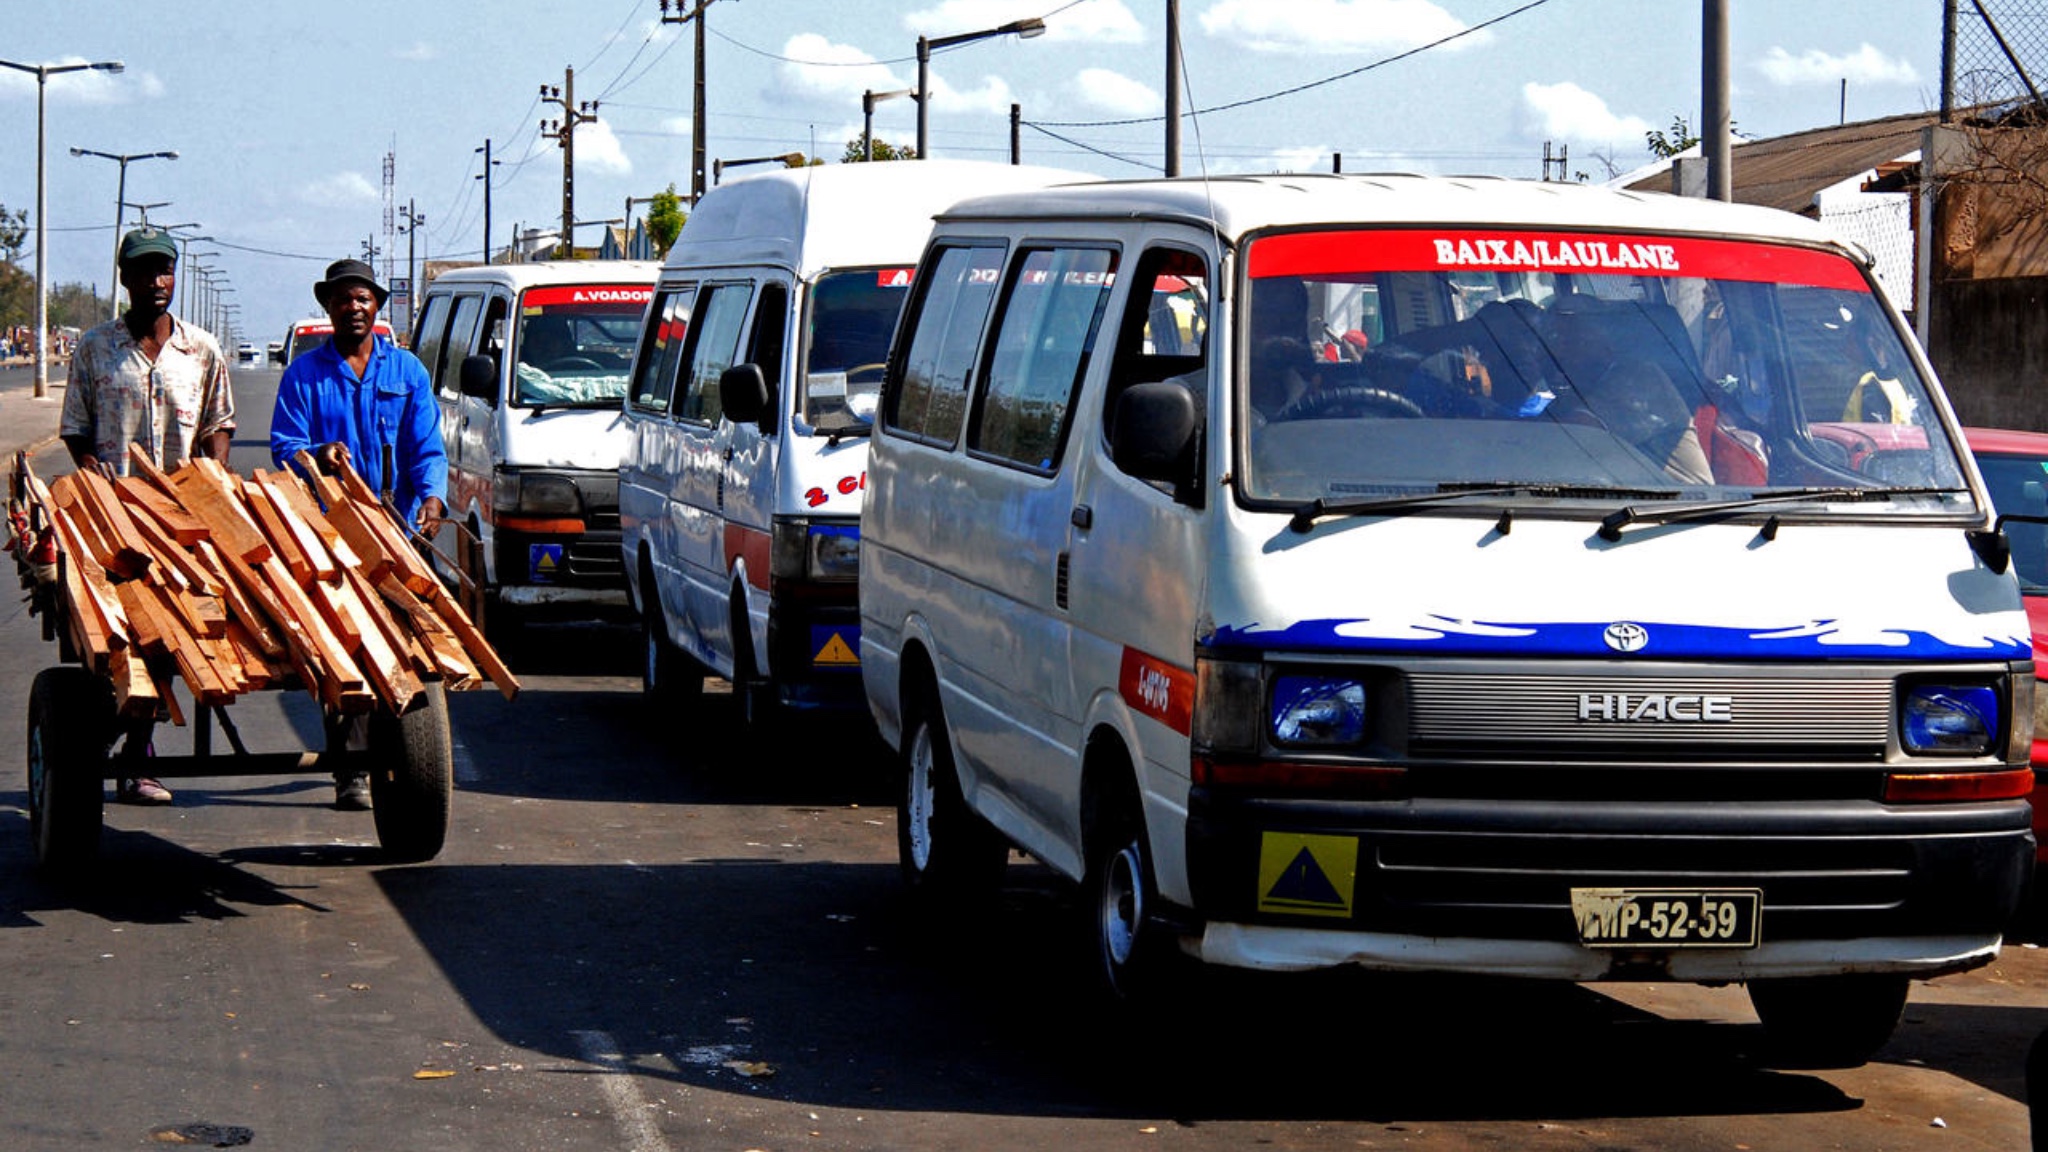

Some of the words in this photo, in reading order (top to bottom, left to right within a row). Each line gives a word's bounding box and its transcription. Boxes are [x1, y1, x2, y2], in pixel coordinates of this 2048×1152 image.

[1433, 239, 1680, 271] BAIXA/LAULANE
[804, 486, 829, 508] 2
[1578, 694, 1732, 721] HIACE
